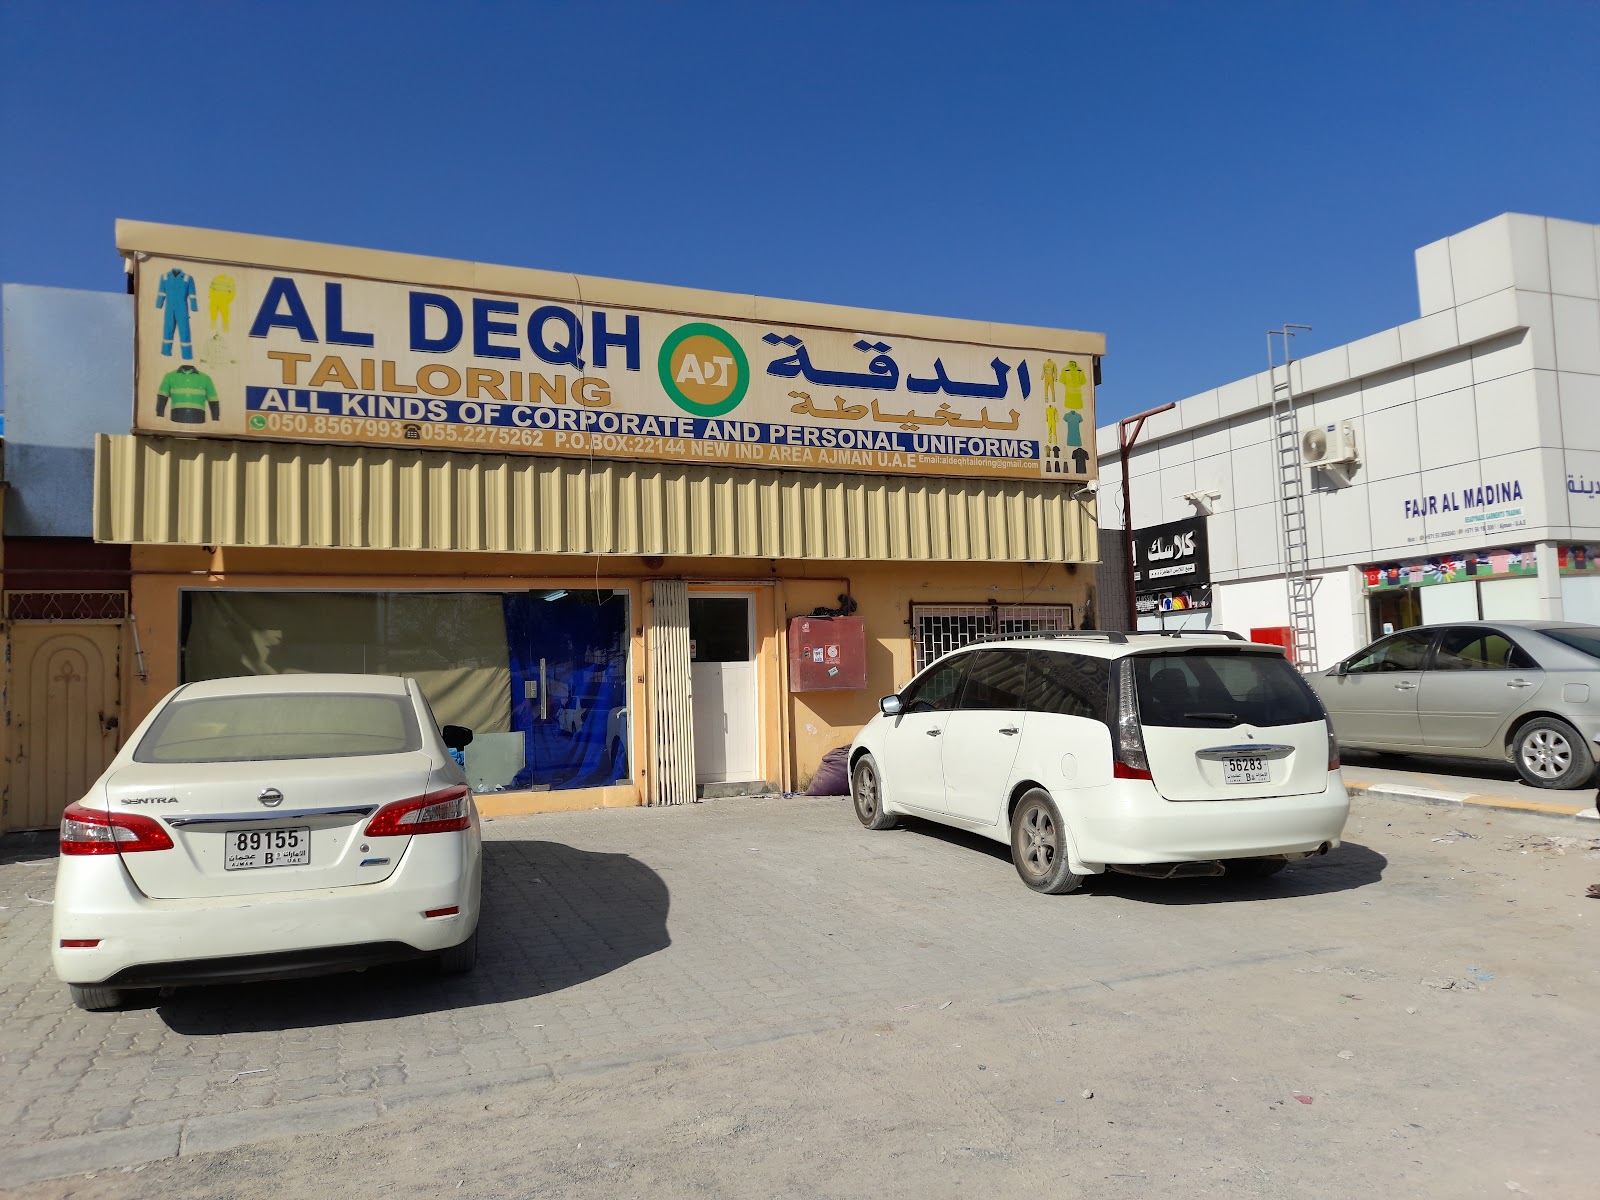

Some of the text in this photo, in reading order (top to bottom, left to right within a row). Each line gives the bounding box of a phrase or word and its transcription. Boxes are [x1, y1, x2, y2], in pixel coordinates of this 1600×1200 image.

[249, 276, 641, 372] AL DEQH
[268, 351, 611, 408] TAILORING
[762, 332, 1031, 401] الدقة
[259, 388, 1034, 458] ALL KINDS OF CORPORATE AND PERSONAL UNIFORMS
[787, 390, 1021, 431] للخياطة
[267, 413, 402, 438] 050.8567993
[421, 424, 544, 447] 055.2275262
[691, 440, 731, 458] NEW
[735, 443, 764, 460] IND
[768, 445, 817, 463] AREA
[817, 448, 873, 466] AJMAN
[877, 451, 917, 469] U.A.E
[1405, 480, 1523, 519] FAJR AL MADINA
[1229, 758, 1262, 771] 56283
[121, 797, 178, 805] SENTRA
[237, 830, 298, 851] 89155
[265, 852, 274, 864] B
